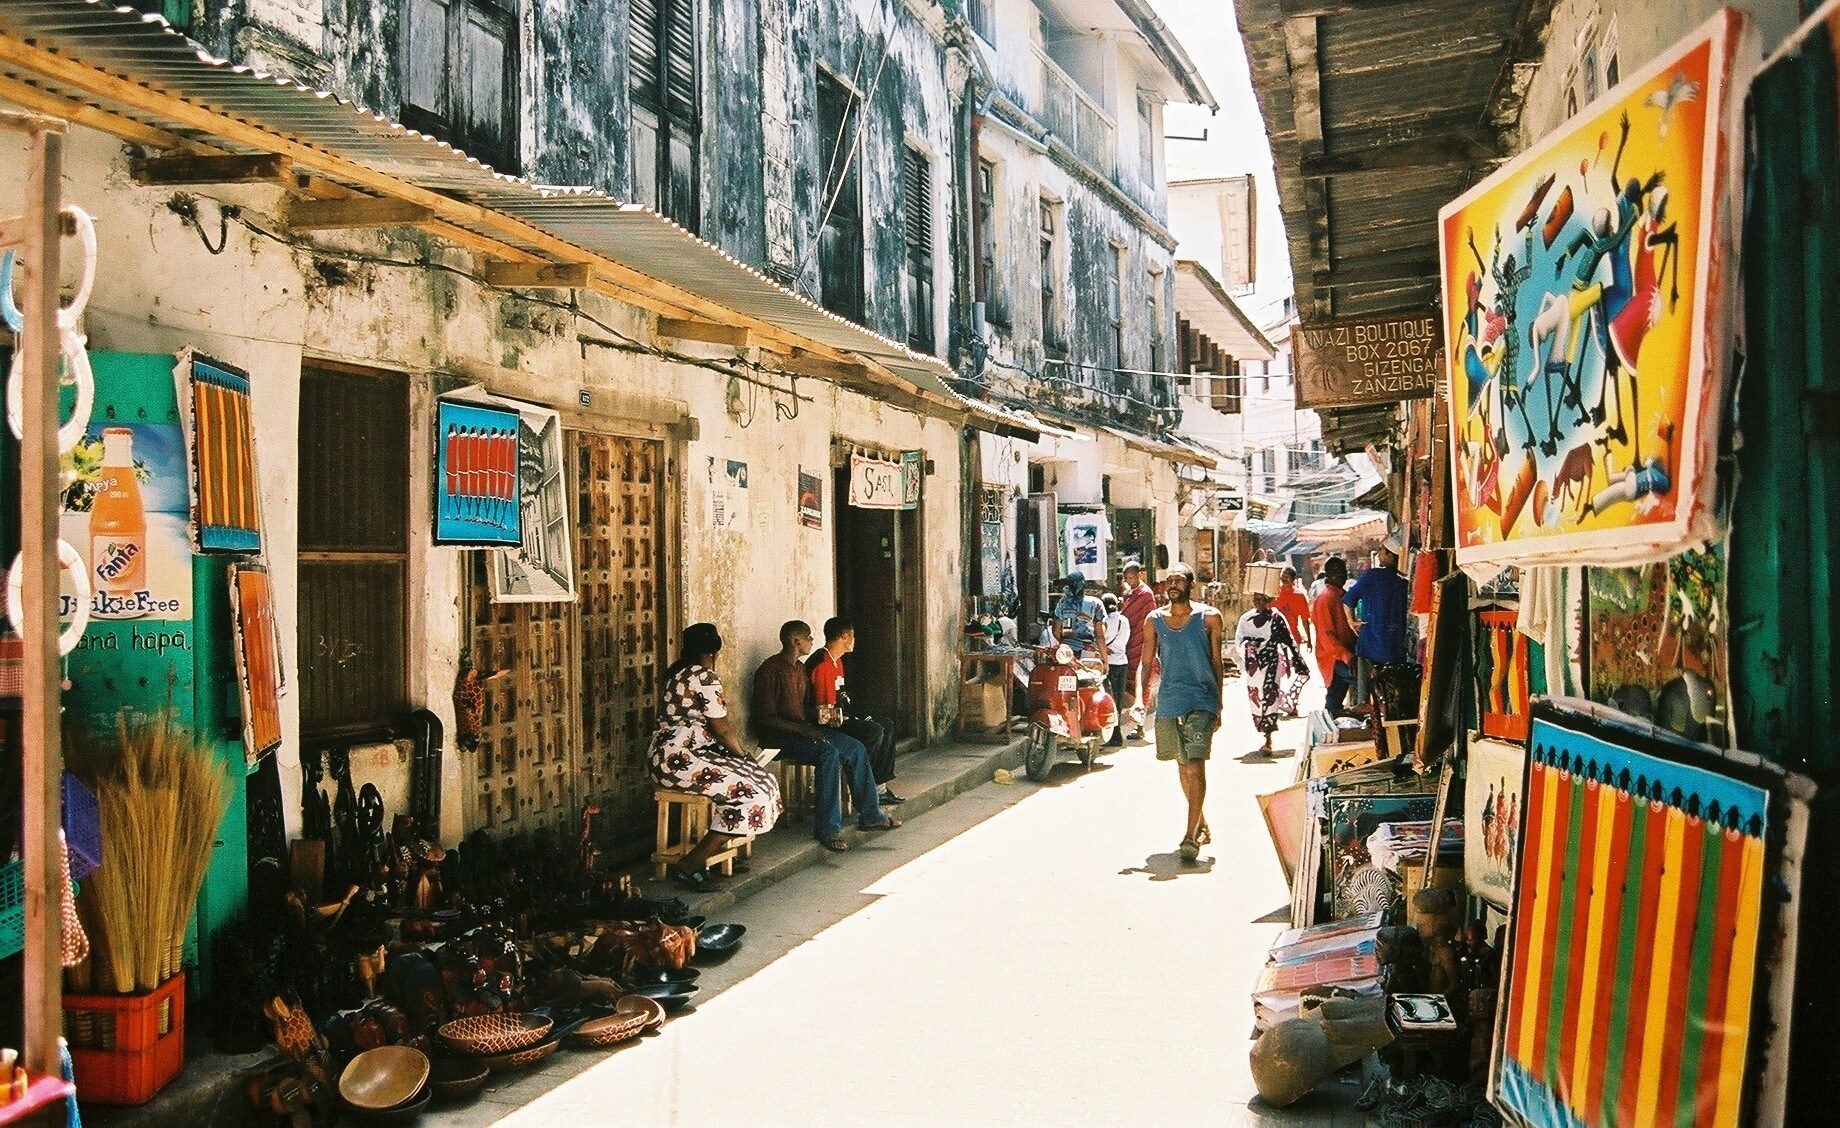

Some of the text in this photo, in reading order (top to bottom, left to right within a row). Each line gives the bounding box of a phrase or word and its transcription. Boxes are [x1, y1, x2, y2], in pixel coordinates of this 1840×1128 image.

[1355, 318, 1435, 344] BOUTIQUE
[1346, 339, 1432, 363] BOX 2067
[1363, 358, 1434, 378] GIZENGA
[1351, 374, 1436, 395] ZANZIBAR
[96, 542, 139, 582] Fanta
[60, 590, 179, 616] JiikieFree
[132, 625, 192, 656] hapa.
